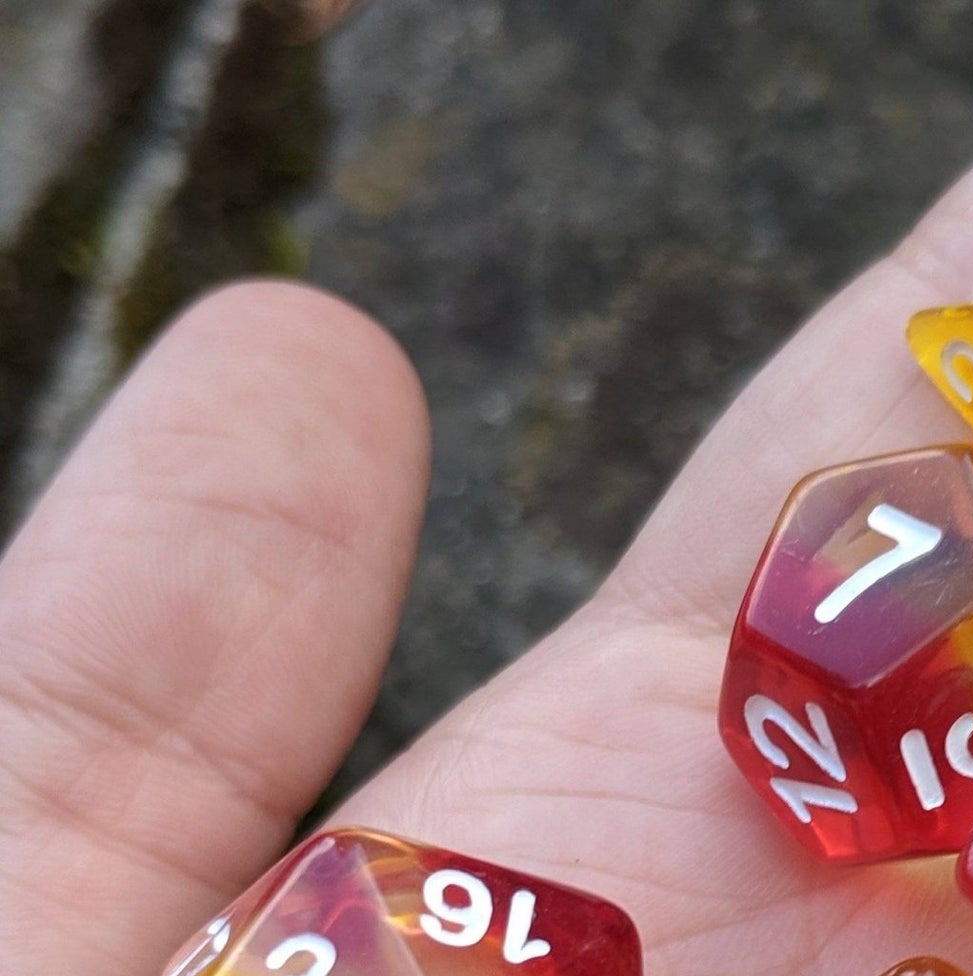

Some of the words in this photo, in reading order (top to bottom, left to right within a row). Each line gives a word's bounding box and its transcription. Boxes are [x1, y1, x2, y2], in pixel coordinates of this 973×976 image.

[814, 503, 942, 624] 7
[744, 694, 858, 823] 12
[419, 869, 551, 965] 16
